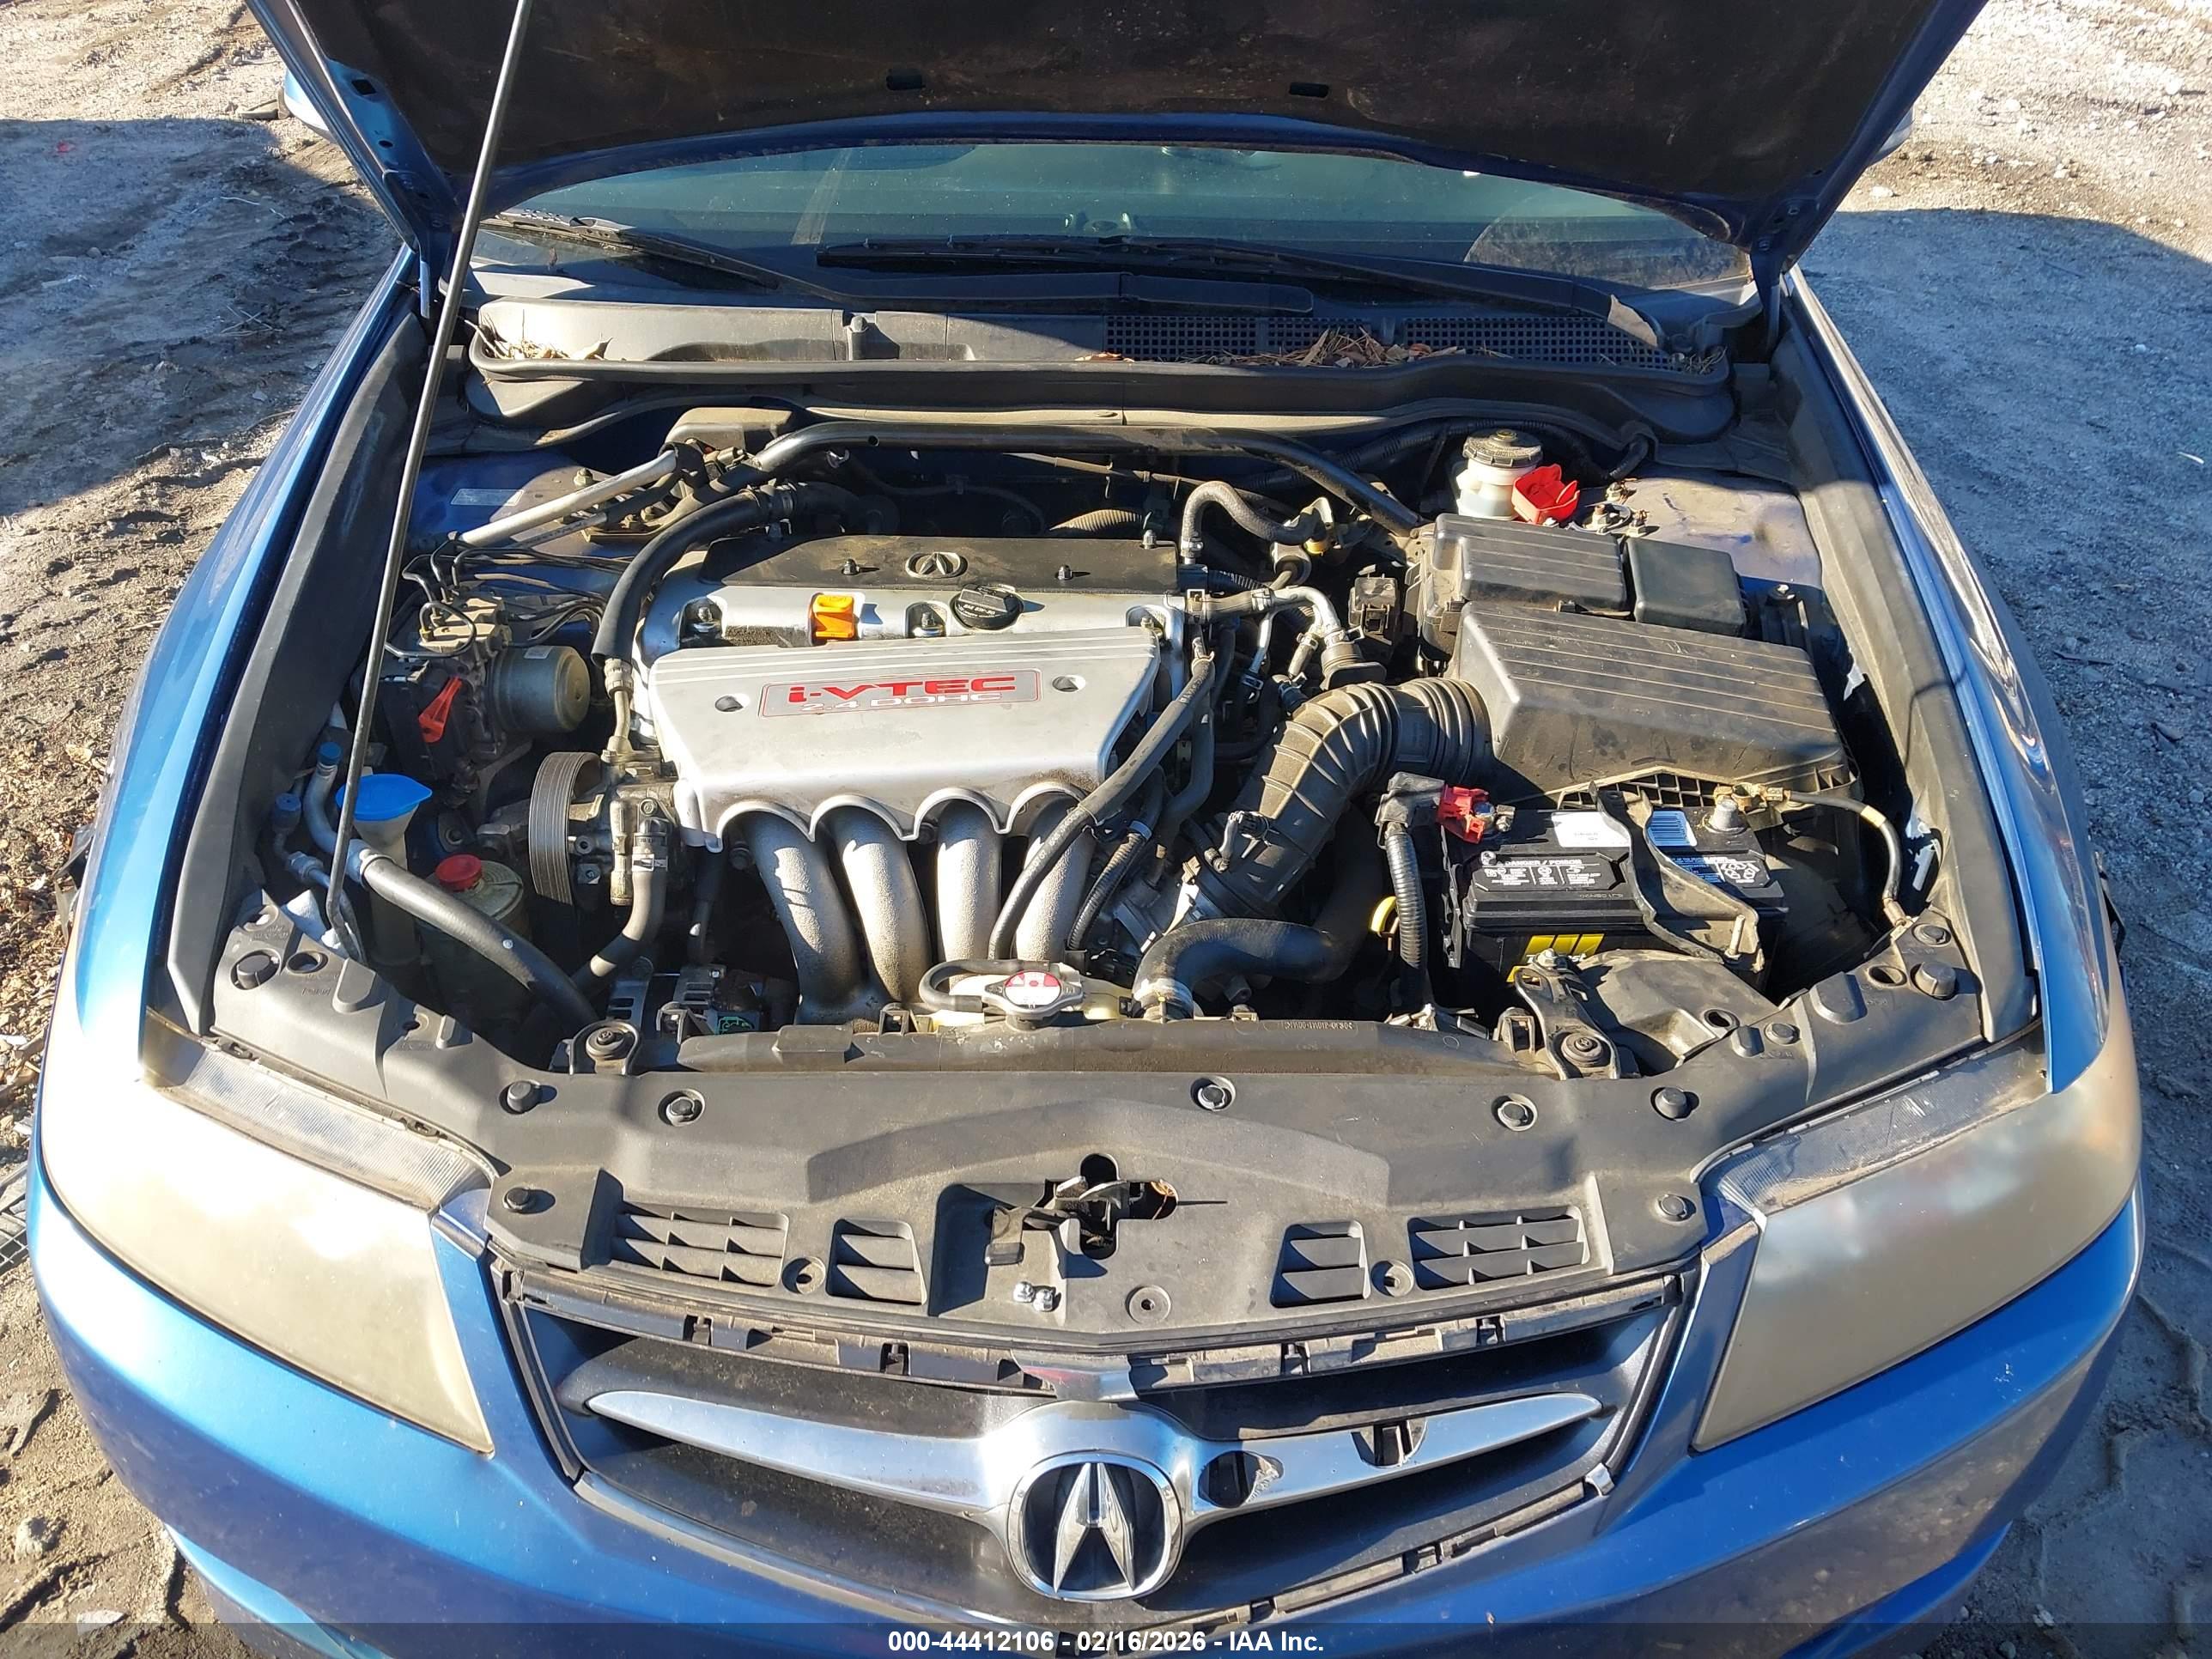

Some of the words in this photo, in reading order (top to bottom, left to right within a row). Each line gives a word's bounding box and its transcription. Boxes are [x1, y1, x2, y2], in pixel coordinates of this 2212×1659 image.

[788, 676, 1016, 703] i-VTEC
[801, 700, 860, 712] 2.4
[870, 693, 1003, 708] DOHC
